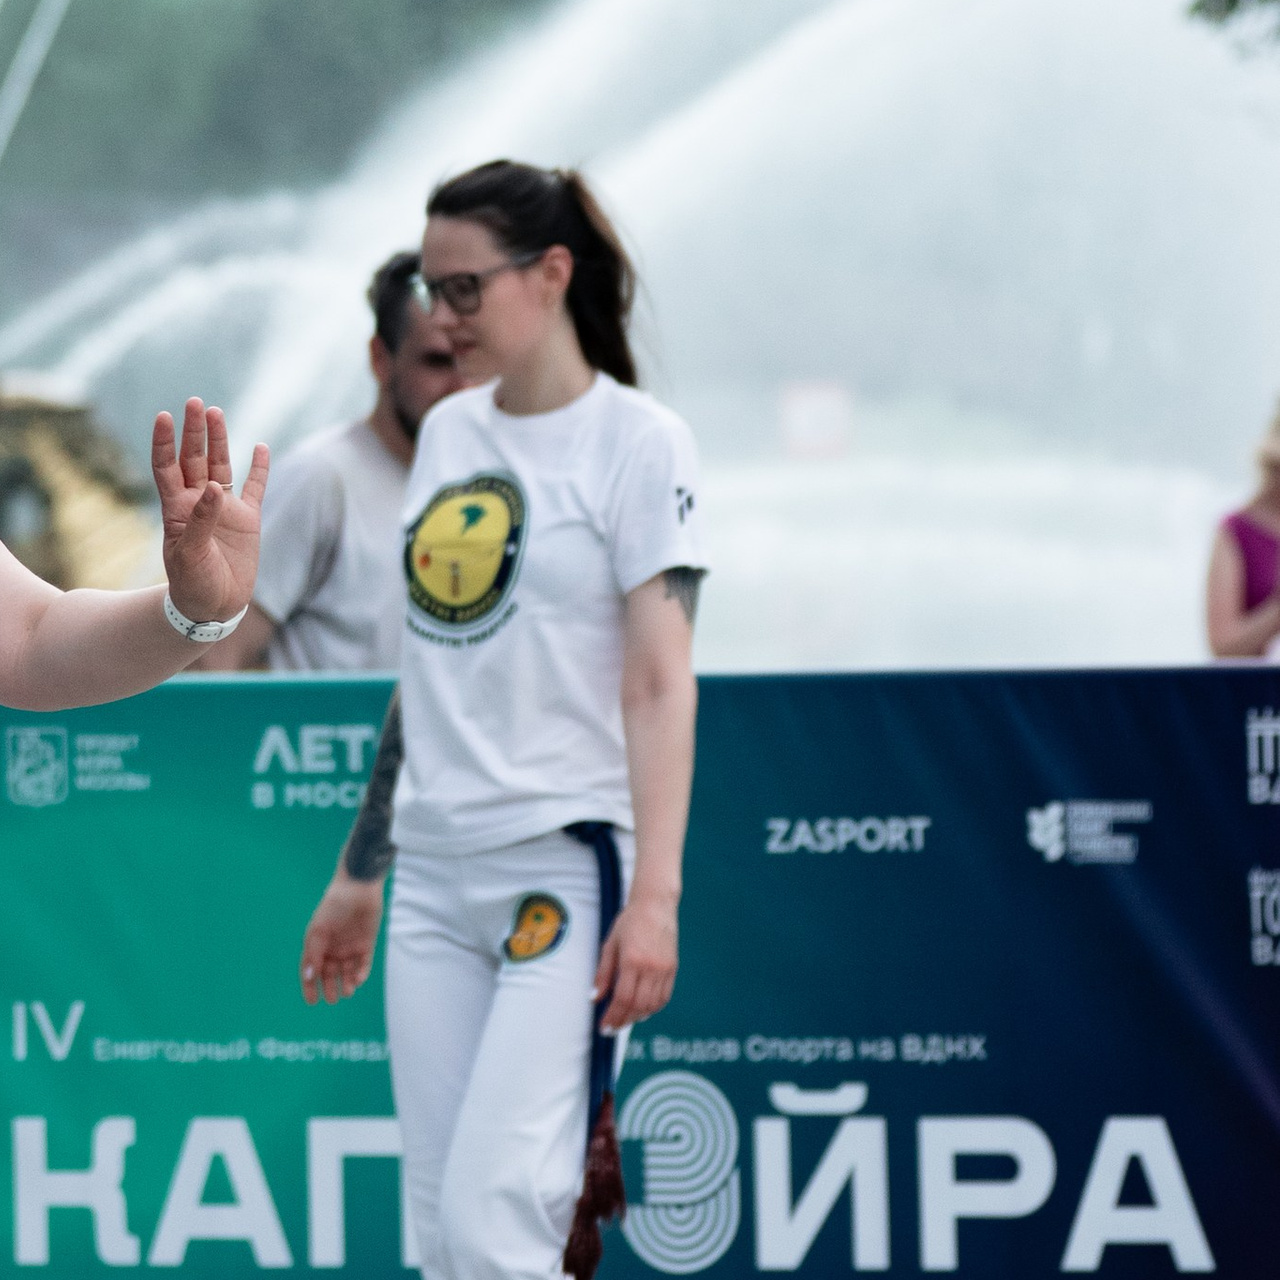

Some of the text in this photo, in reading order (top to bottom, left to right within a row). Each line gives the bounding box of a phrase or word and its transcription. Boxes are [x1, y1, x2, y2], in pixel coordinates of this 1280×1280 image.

[253, 724, 380, 773] ЛЕТ
[765, 816, 930, 853] ZASPORT
[12, 1000, 85, 1061] IV
[92, 1037, 251, 1062] Ежегодный
[650, 1035, 741, 1062] Видов
[744, 1035, 854, 1064] Спорта
[858, 1037, 895, 1061] на
[901, 1035, 986, 1064] ВДНХ
